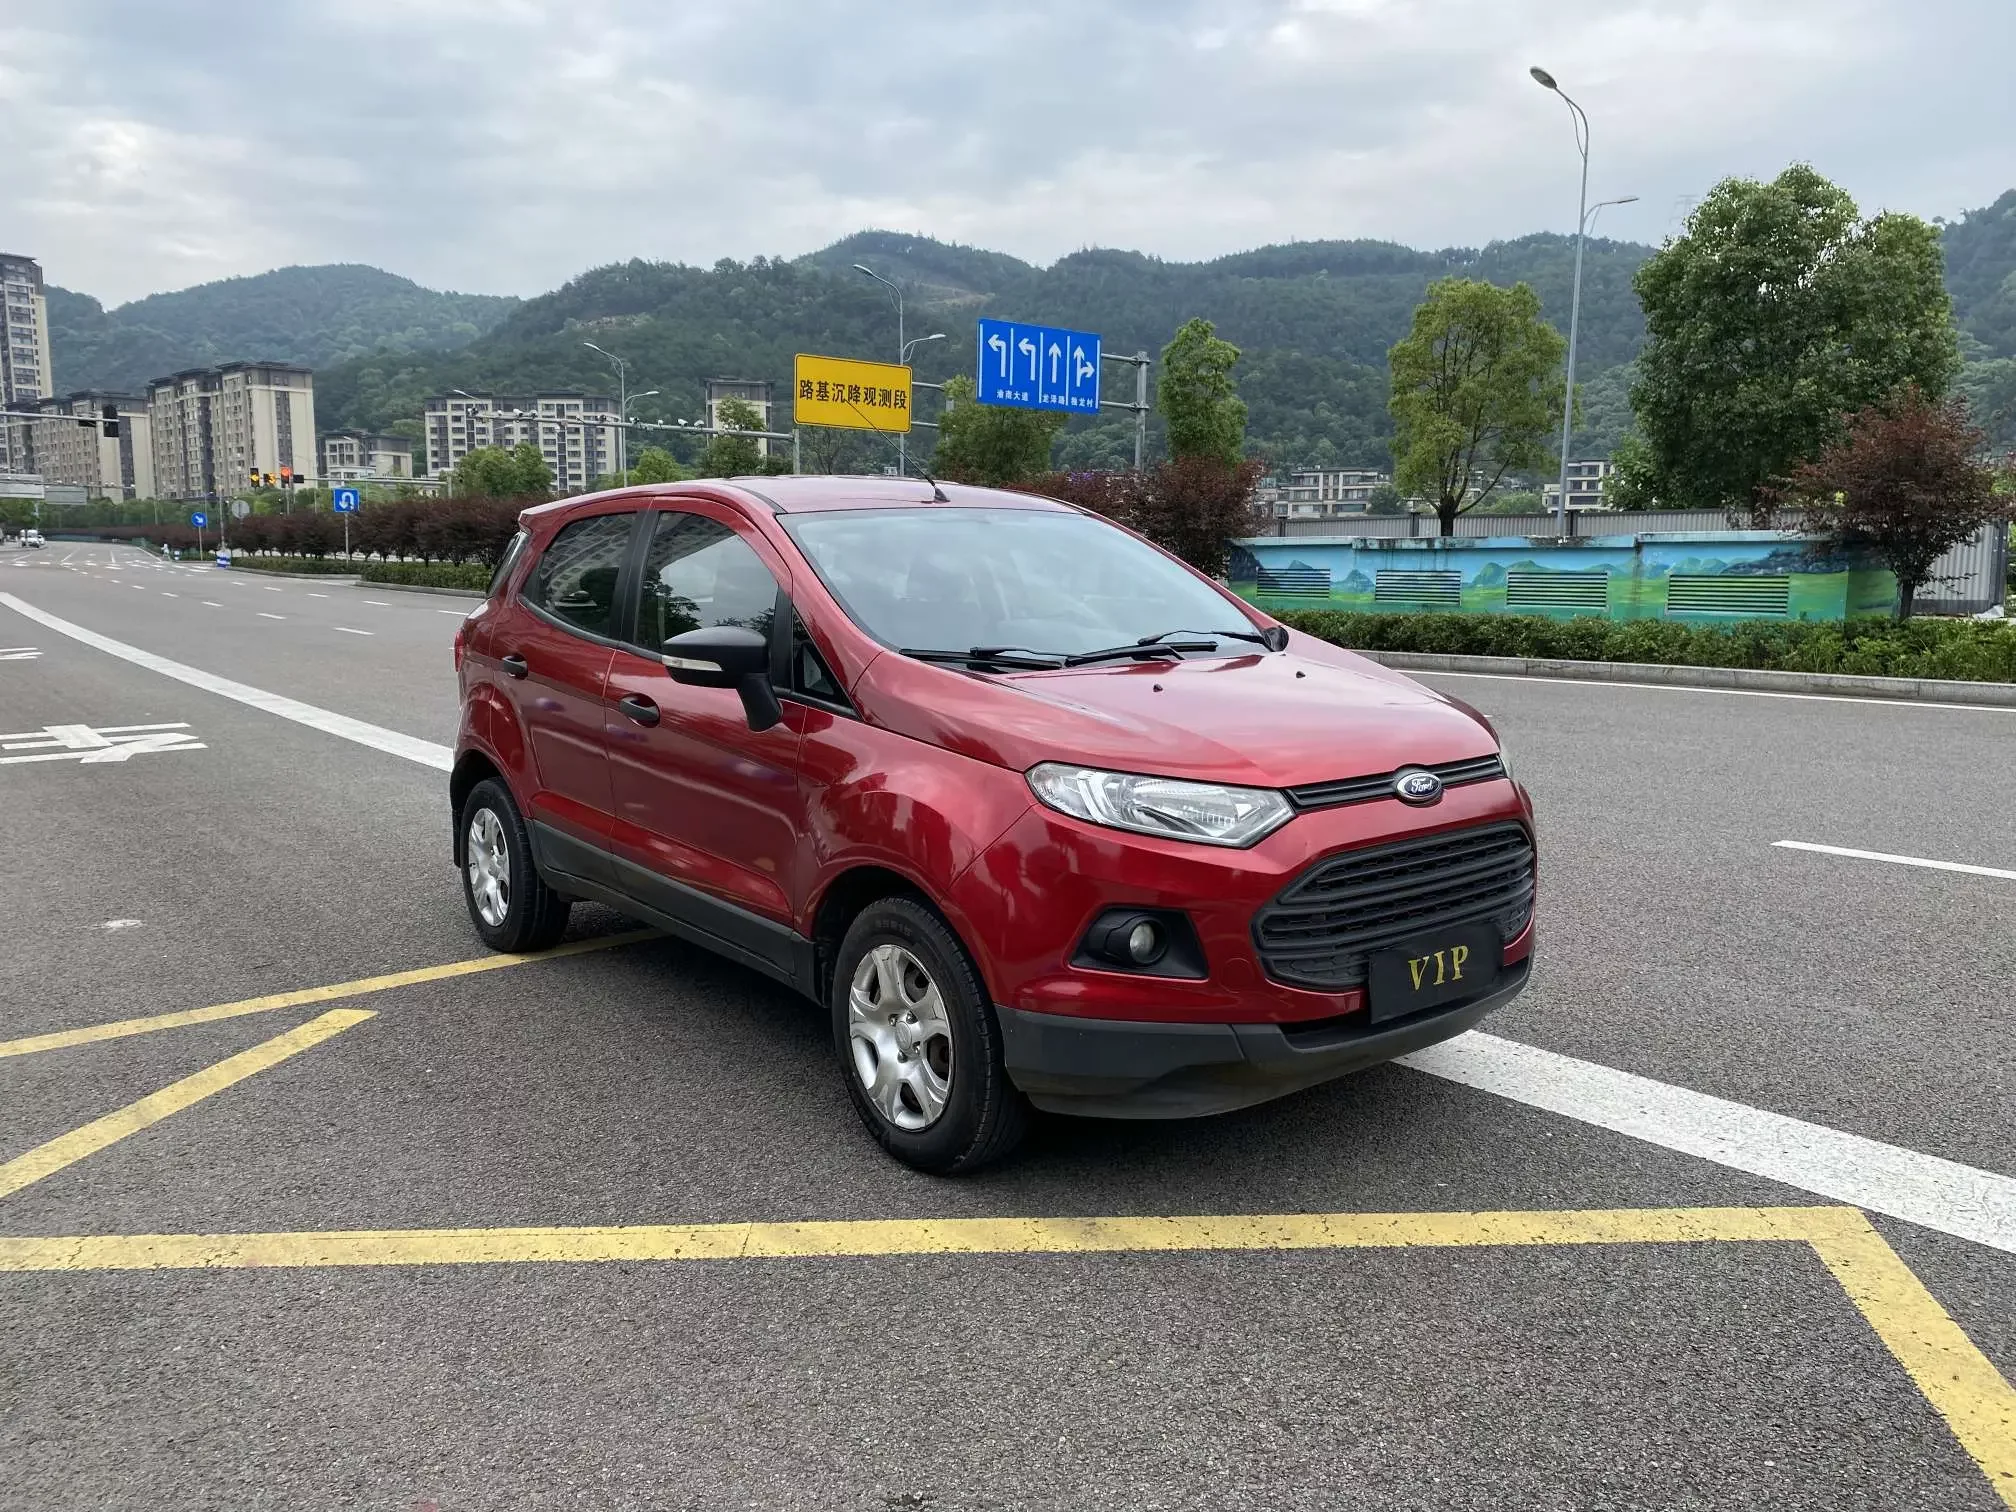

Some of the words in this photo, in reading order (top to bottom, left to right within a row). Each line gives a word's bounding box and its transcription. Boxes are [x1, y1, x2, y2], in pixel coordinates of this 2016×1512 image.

[799, 380, 907, 409] 路基沉降观测段
[1411, 778, 1433, 793] Ford
[1408, 945, 1469, 991] VIP
